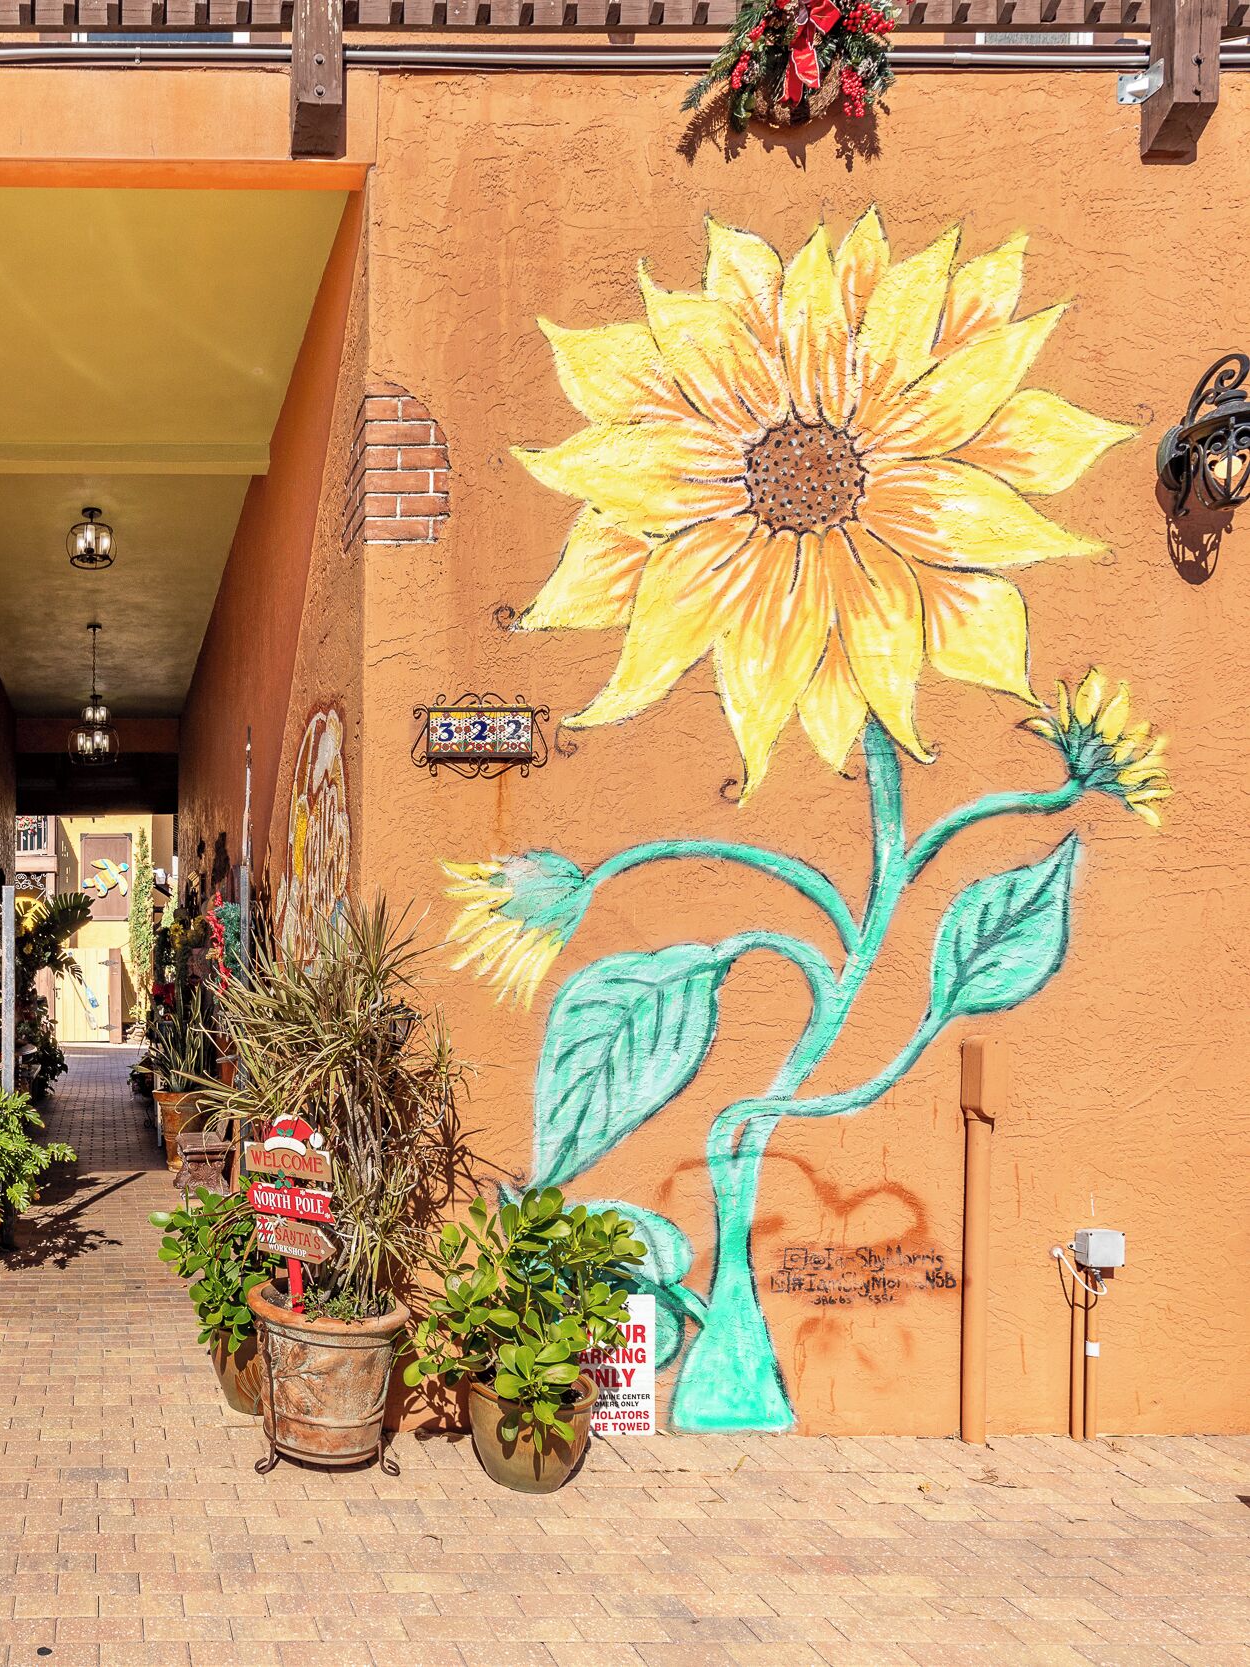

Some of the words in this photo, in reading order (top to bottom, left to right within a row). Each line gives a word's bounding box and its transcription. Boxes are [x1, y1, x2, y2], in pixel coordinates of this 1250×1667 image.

[437, 719, 522, 742] 322
[250, 1150, 324, 1174] WELCOME
[253, 1190, 292, 1210] NORTH
[295, 1196, 325, 1215] POLE
[275, 1226, 321, 1250] SANTA'S
[268, 1242, 307, 1258] WORKSHOP
[579, 1348, 646, 1364] ARKING
[591, 1410, 650, 1420] VIOLATORS
[594, 1423, 608, 1432] BE
[612, 1422, 651, 1432] TOWED
